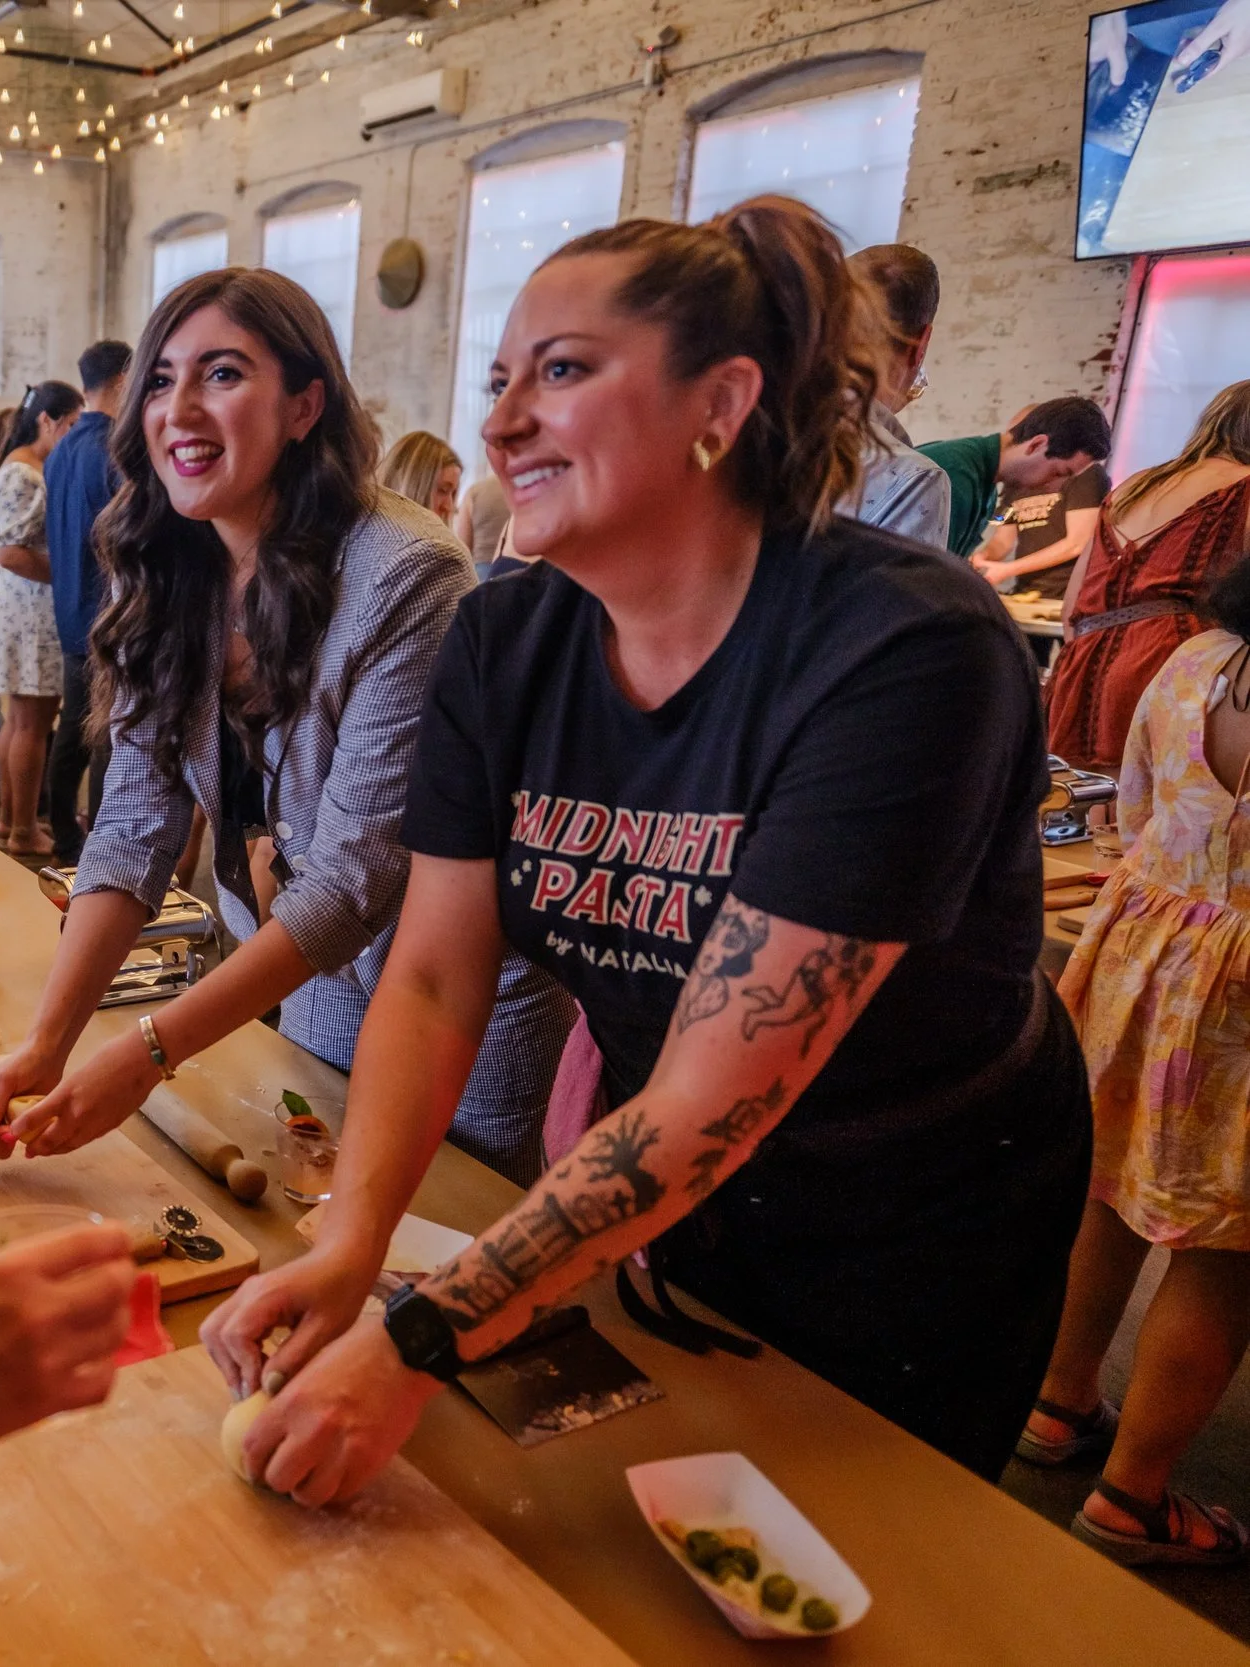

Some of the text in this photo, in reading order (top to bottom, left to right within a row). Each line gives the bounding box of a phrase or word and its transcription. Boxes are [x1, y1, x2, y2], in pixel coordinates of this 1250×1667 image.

[511, 790, 745, 876] MIDNIGHT
[530, 859, 692, 944] PASTA
[546, 931, 573, 956] by
